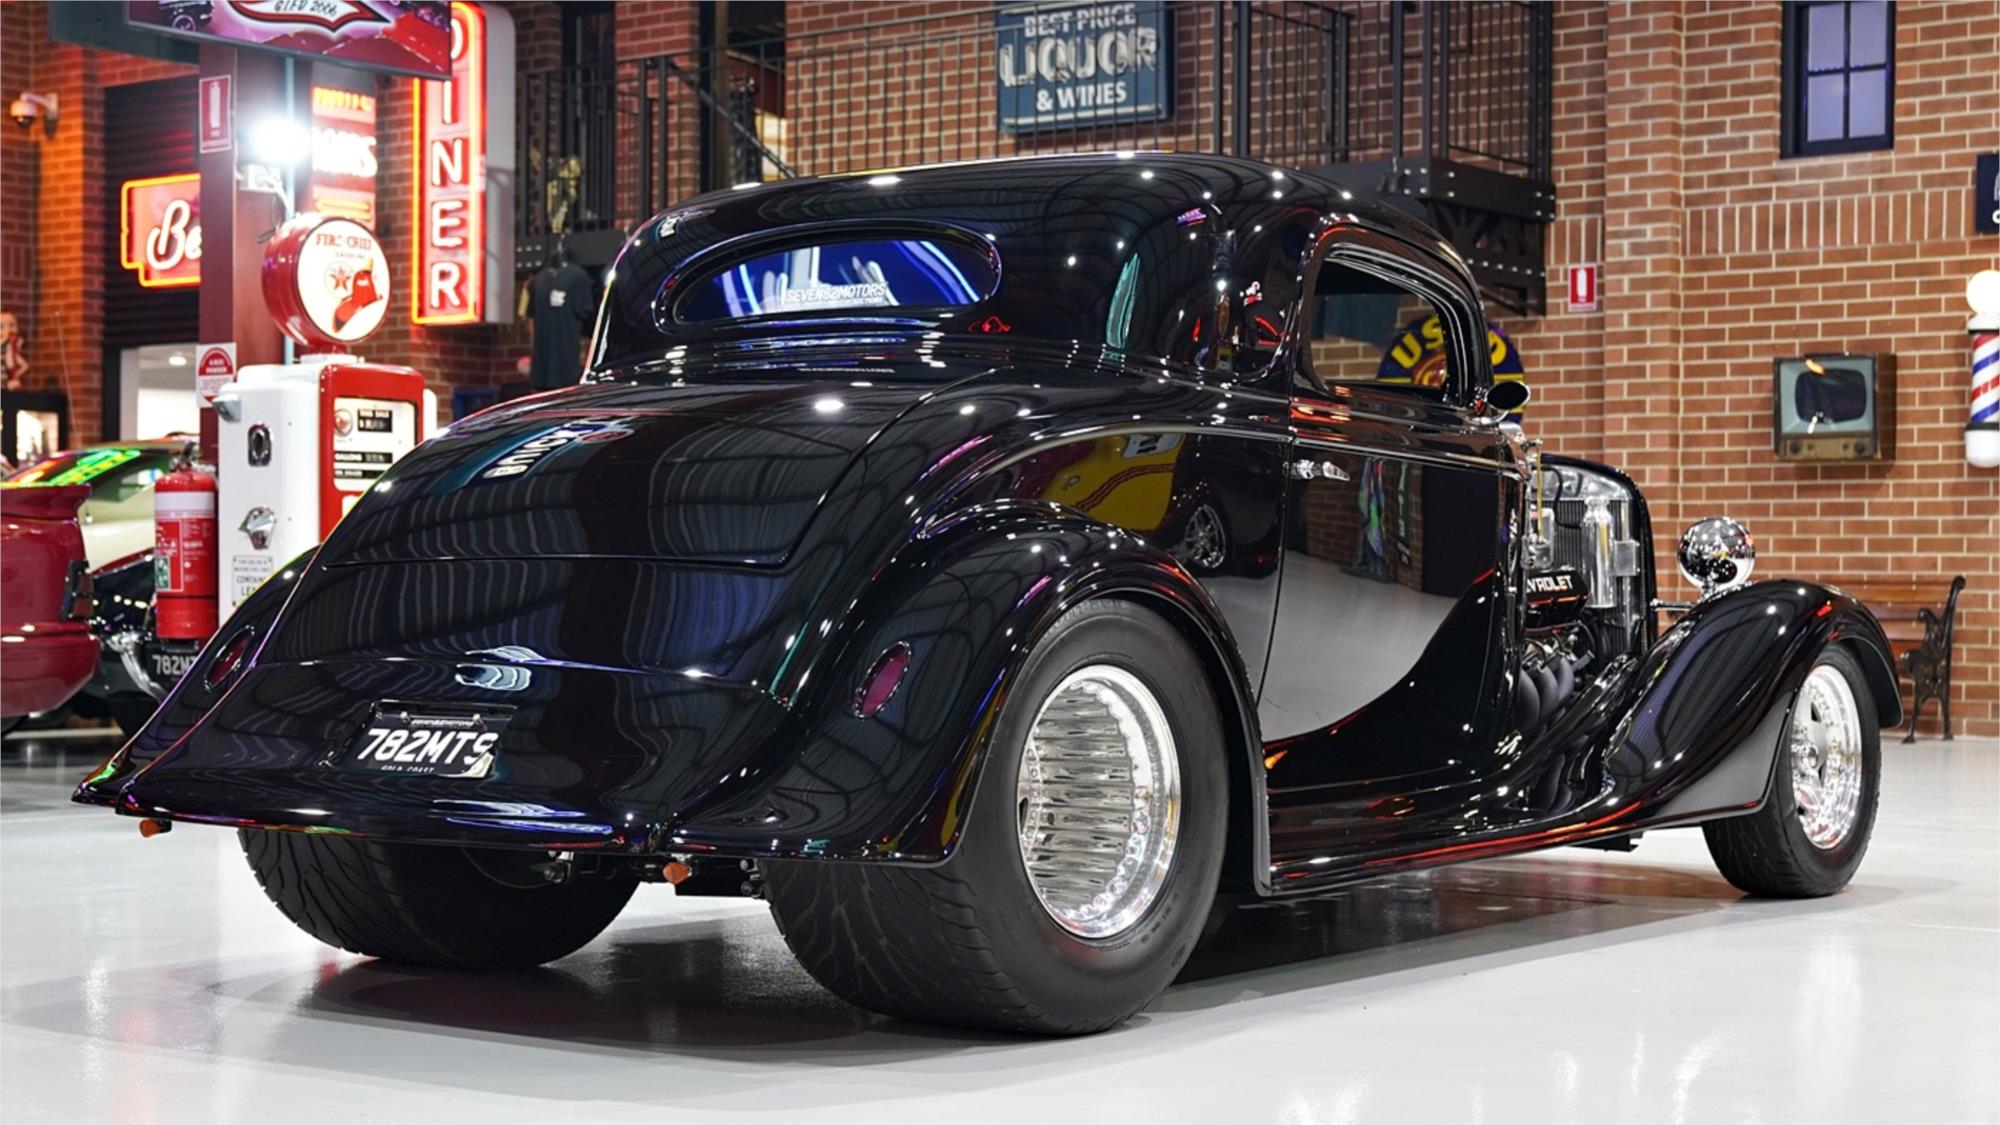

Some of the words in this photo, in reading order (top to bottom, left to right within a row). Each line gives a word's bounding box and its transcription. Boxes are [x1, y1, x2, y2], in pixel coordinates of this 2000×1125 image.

[1024, 11, 1073, 37] BEST
[1076, 4, 1136, 31] PRICE
[1000, 27, 1157, 87] LIQUOR
[1036, 90, 1054, 112] &
[1056, 81, 1127, 109] WINES
[146, 199, 202, 270] Be
[787, 282, 888, 302] SEVEN82MOTORS
[357, 728, 499, 766] 782MTS
